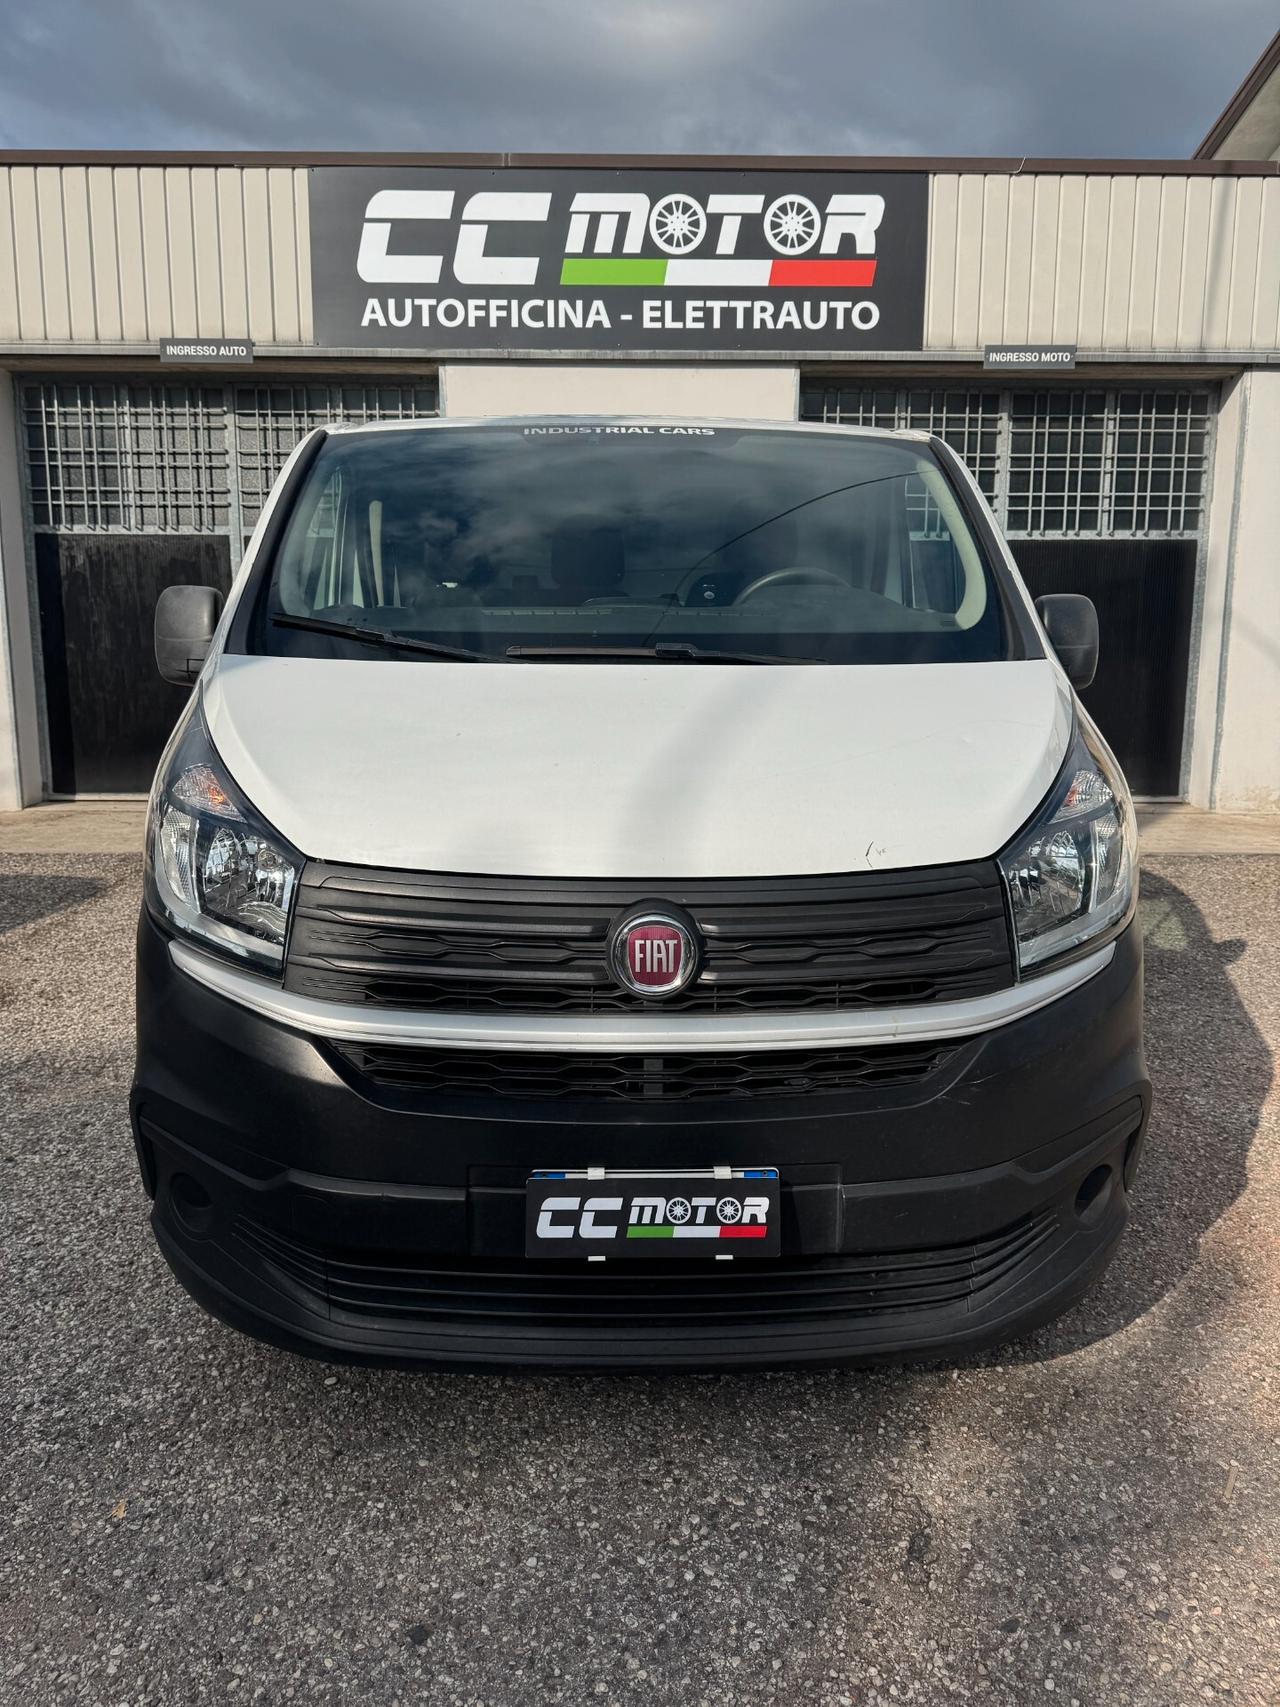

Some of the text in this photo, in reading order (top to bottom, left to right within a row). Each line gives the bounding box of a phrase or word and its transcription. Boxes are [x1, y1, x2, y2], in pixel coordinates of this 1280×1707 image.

[357, 189, 885, 285] CC MOTOR
[361, 298, 611, 329] AUTOFFICINA
[643, 301, 880, 330] ELETTRAUTO
[166, 345, 247, 356] INGRESSO AUTO
[989, 352, 1071, 362] INGRESSO MOTO
[524, 426, 715, 436] INDUSTRIAL CARS
[635, 940, 677, 973] FIAT
[536, 1197, 770, 1238] CC MOTOR
